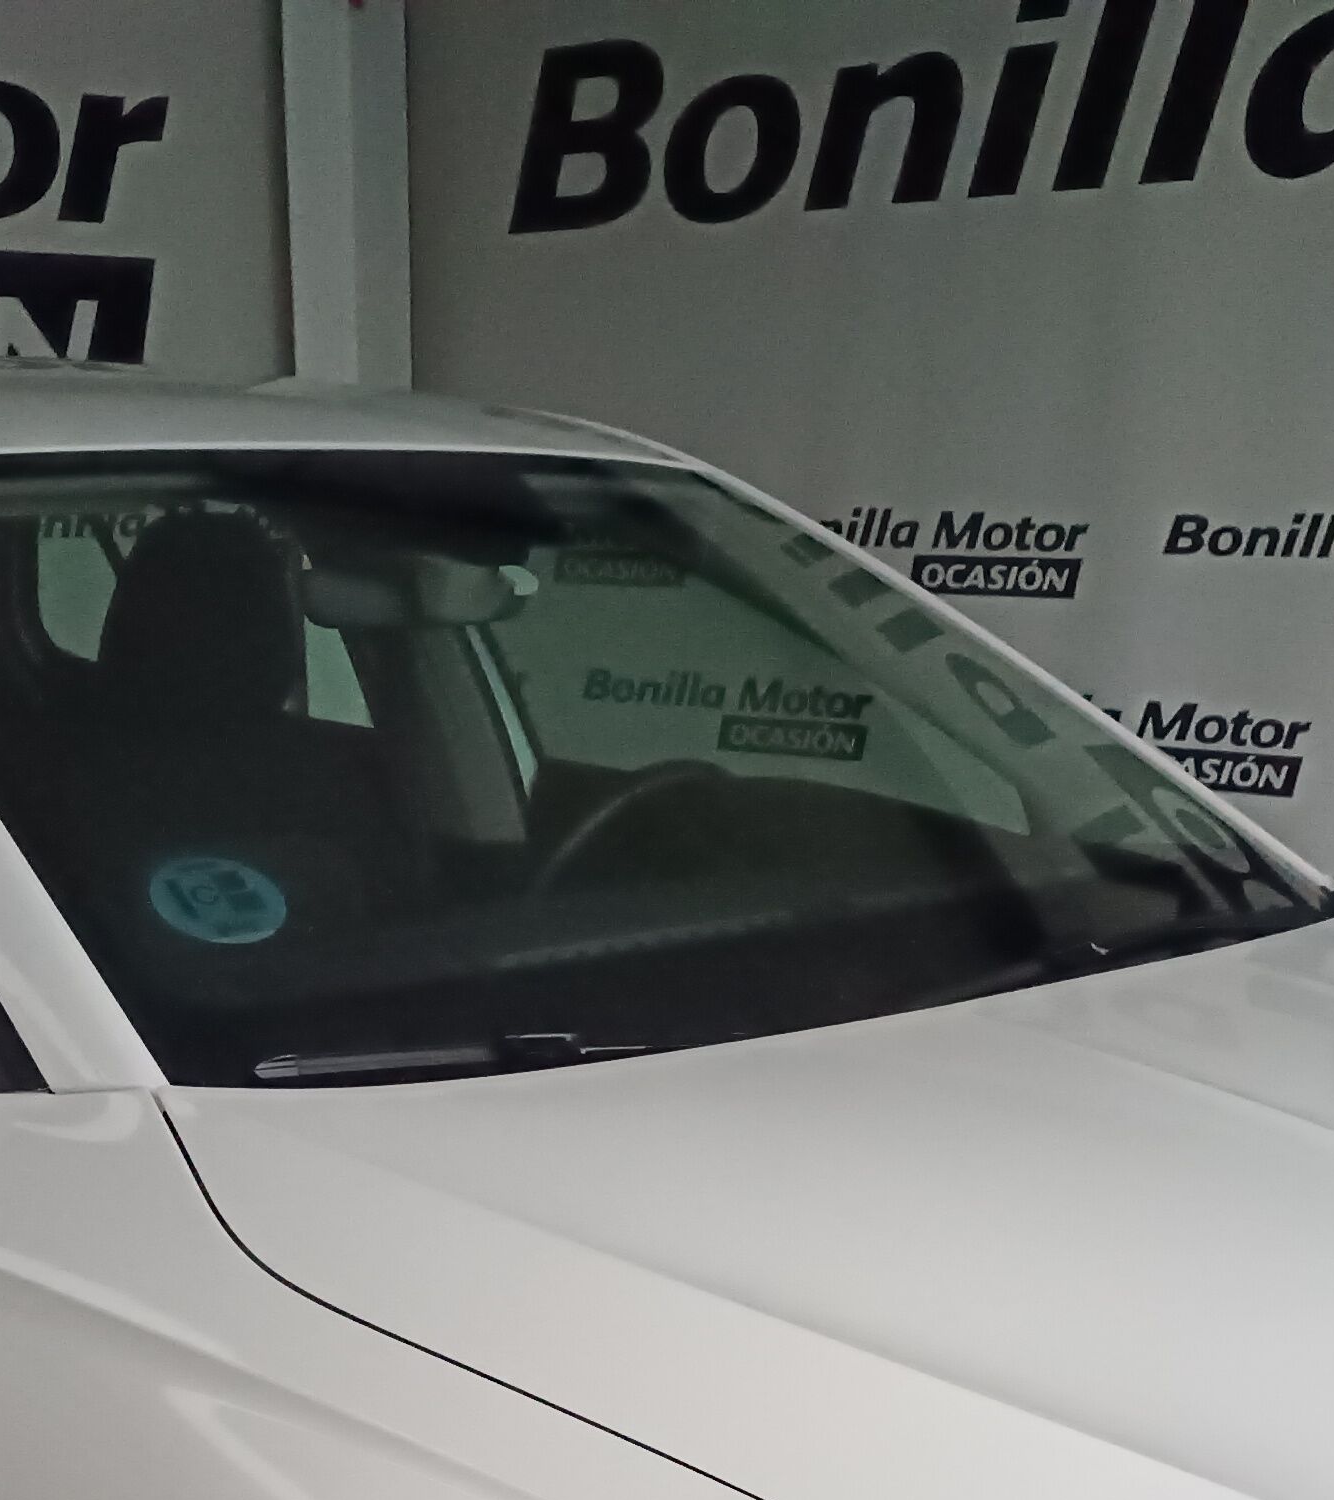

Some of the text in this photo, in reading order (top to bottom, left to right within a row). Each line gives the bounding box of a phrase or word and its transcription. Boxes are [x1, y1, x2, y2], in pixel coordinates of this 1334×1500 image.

[933, 510, 1089, 552] Motor
[921, 557, 1070, 592] OCASIÓN
[739, 675, 874, 720] Motor
[1137, 700, 1312, 750] Motor
[1170, 755, 1289, 790] ASIÓN
